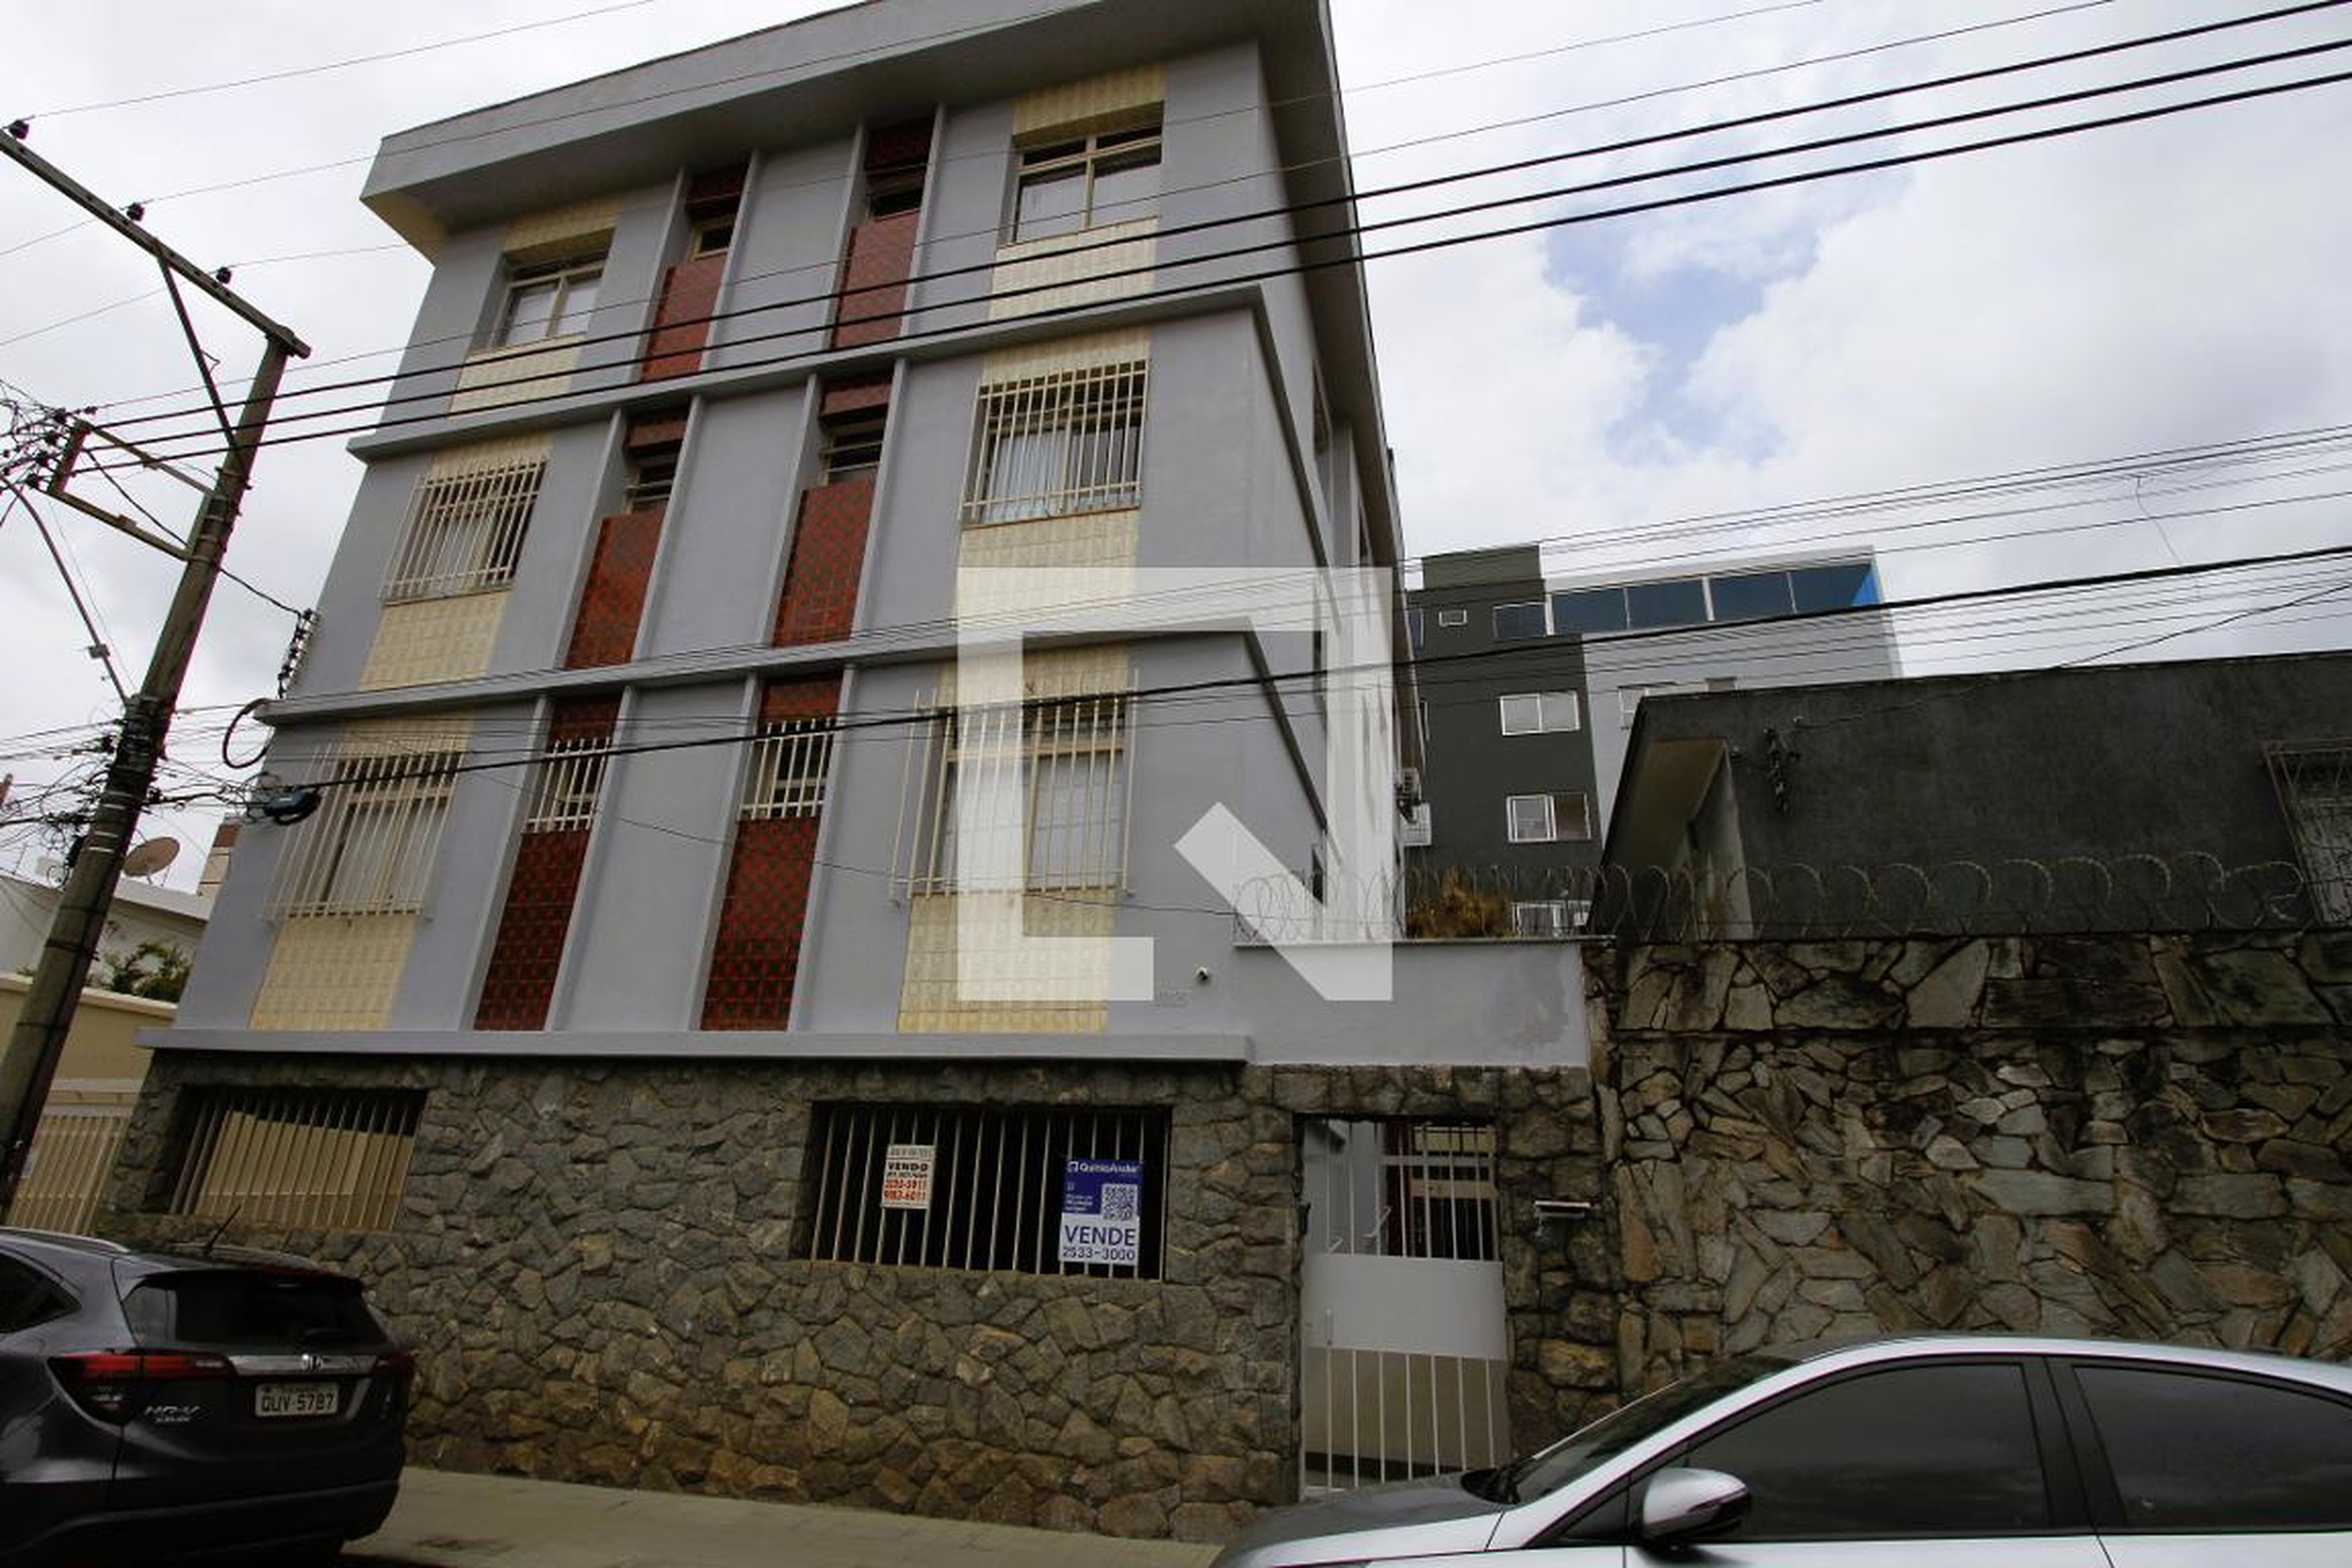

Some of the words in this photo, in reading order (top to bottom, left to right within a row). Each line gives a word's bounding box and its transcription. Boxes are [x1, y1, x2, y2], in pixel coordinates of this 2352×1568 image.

[888, 1161, 929, 1172] VENDO
[1065, 1225, 1136, 1246] VENDE
[1063, 1246, 1135, 1261] 2533-3000
